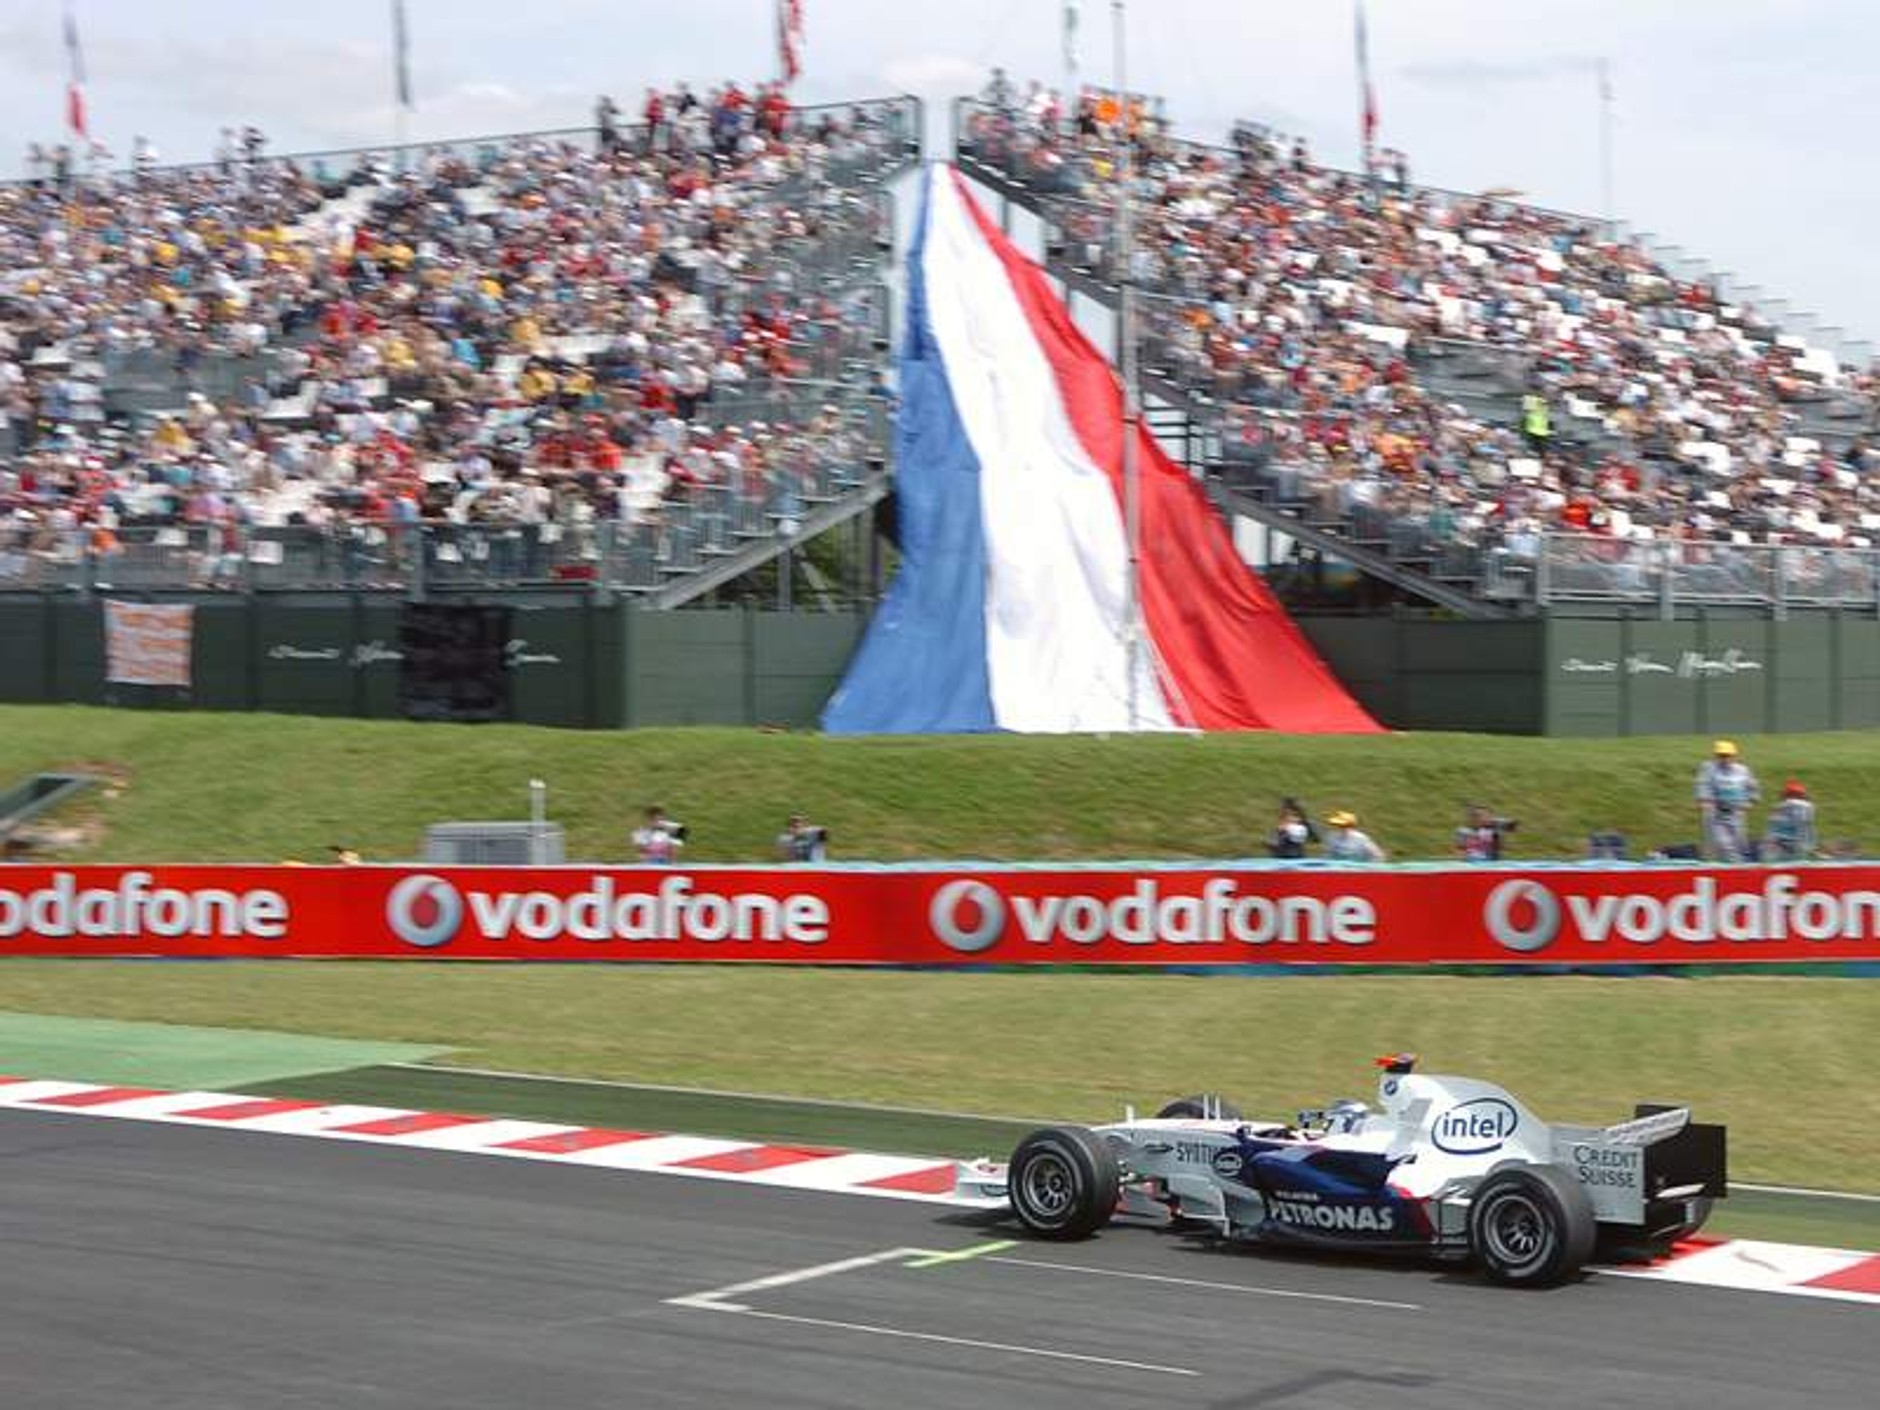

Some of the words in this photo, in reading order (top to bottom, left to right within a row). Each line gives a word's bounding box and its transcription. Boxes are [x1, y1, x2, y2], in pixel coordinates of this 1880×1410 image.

[467, 873, 830, 943] vodafone
[1011, 878, 1375, 946] vodafone
[1565, 874, 1880, 941] vodafon
[1443, 1111, 1503, 1139] intel
[1573, 1144, 1638, 1168] CREDIT
[1578, 1165, 1637, 1188] SUISSE
